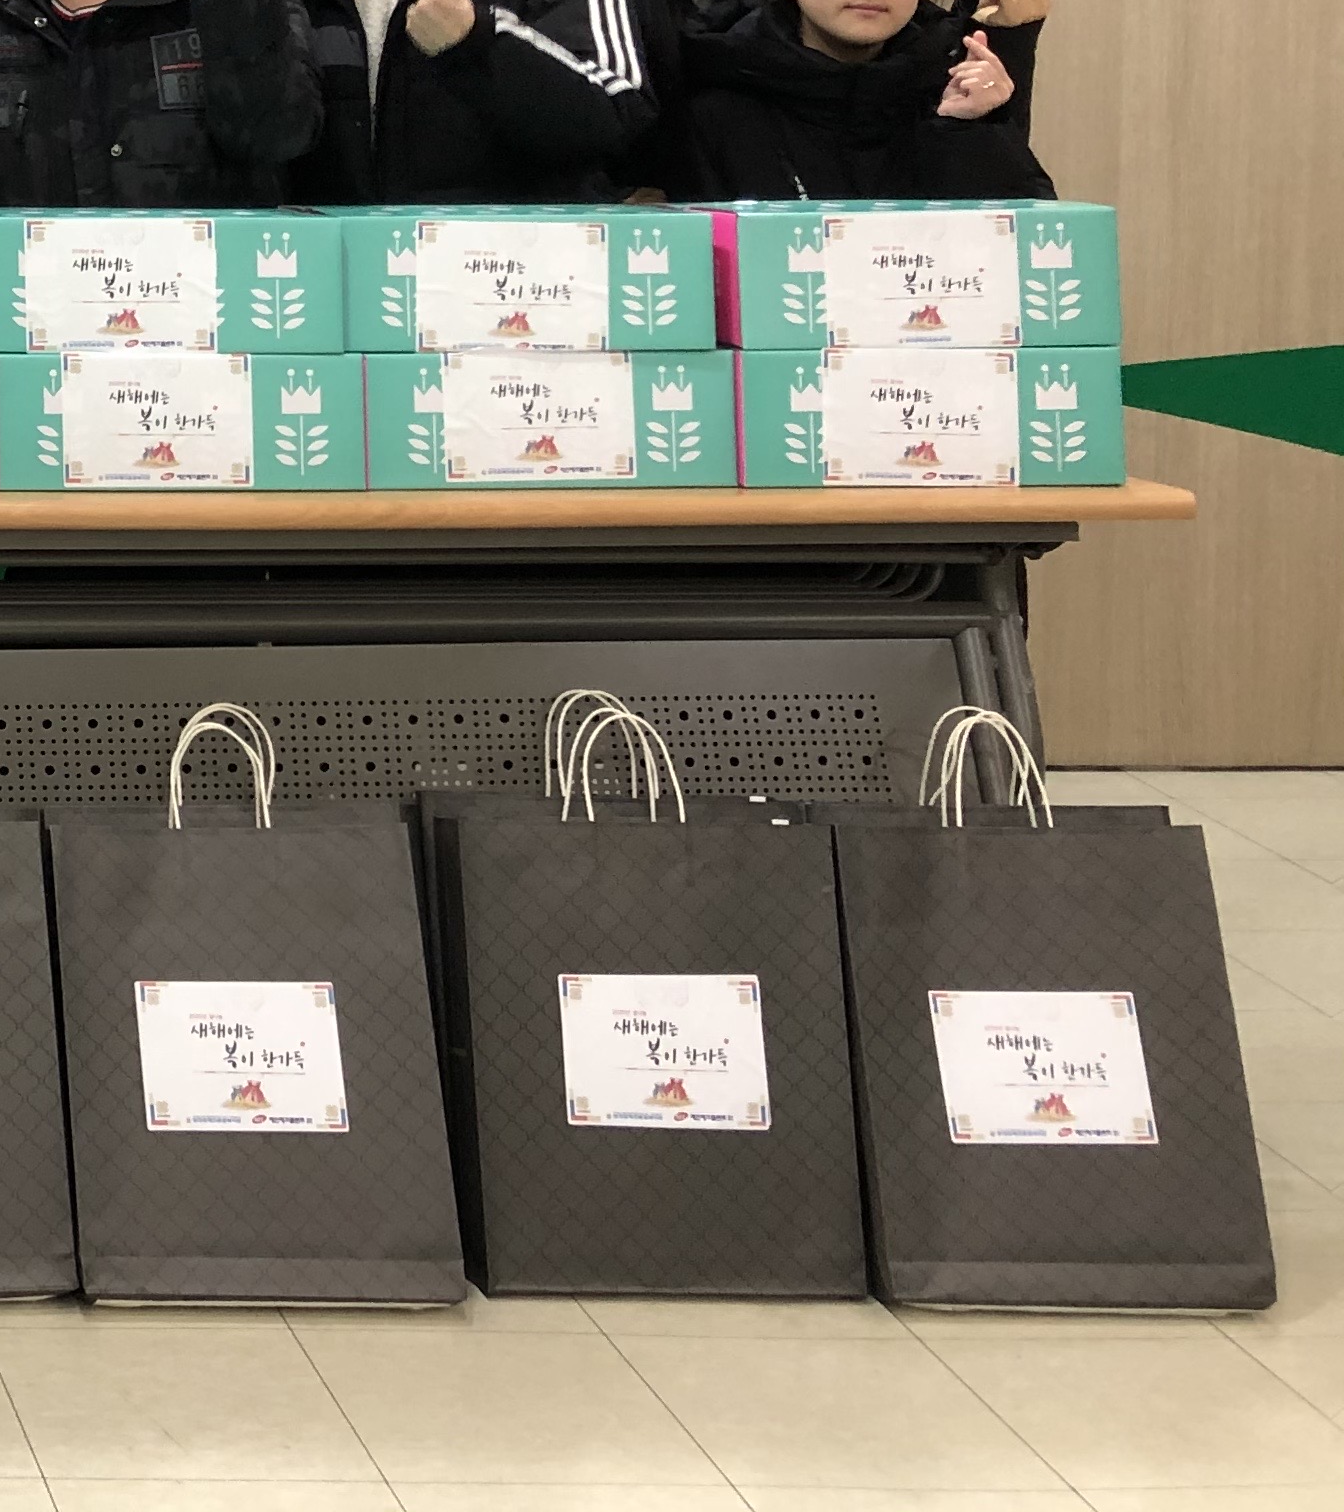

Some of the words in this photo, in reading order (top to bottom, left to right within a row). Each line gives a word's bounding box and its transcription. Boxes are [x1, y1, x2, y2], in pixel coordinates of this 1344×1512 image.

[72, 256, 134, 273] 새해에는
[464, 258, 526, 275] 새해에는
[872, 253, 935, 269] 새해에는
[109, 388, 170, 406] 새해에는
[490, 382, 551, 399] 새해에는
[870, 387, 933, 404] 새해에는
[190, 1021, 255, 1040] 새해에는
[613, 1017, 679, 1037] 새해에는
[987, 1034, 1053, 1052] 새해에는
